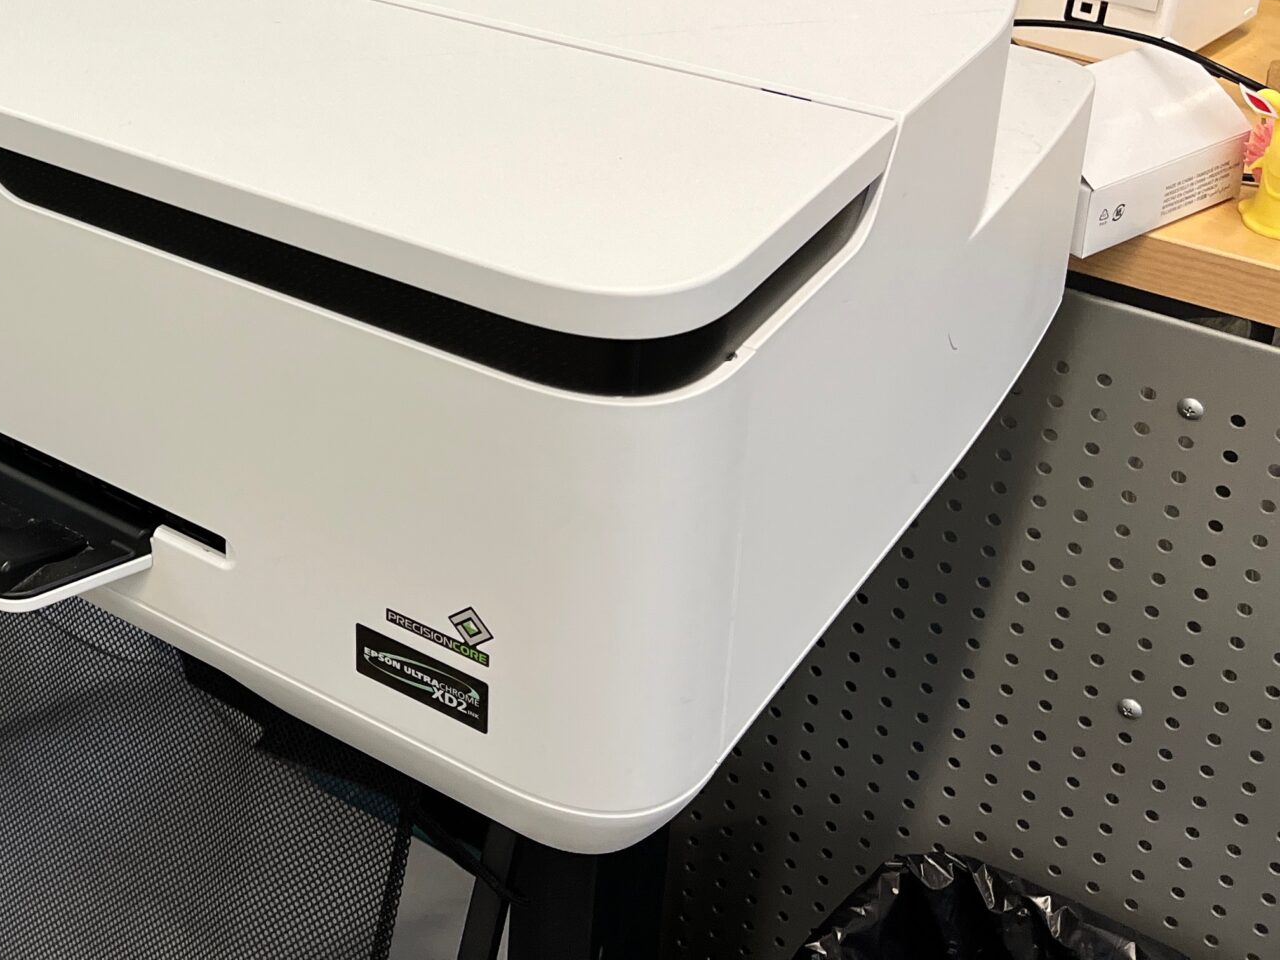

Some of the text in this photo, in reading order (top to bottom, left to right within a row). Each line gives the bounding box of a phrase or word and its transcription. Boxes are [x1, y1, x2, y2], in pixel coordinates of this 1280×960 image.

[387, 611, 487, 665] PRECISIONCORE
[364, 646, 480, 708] EPSON ULTRACHROME
[432, 686, 468, 714] XD2
